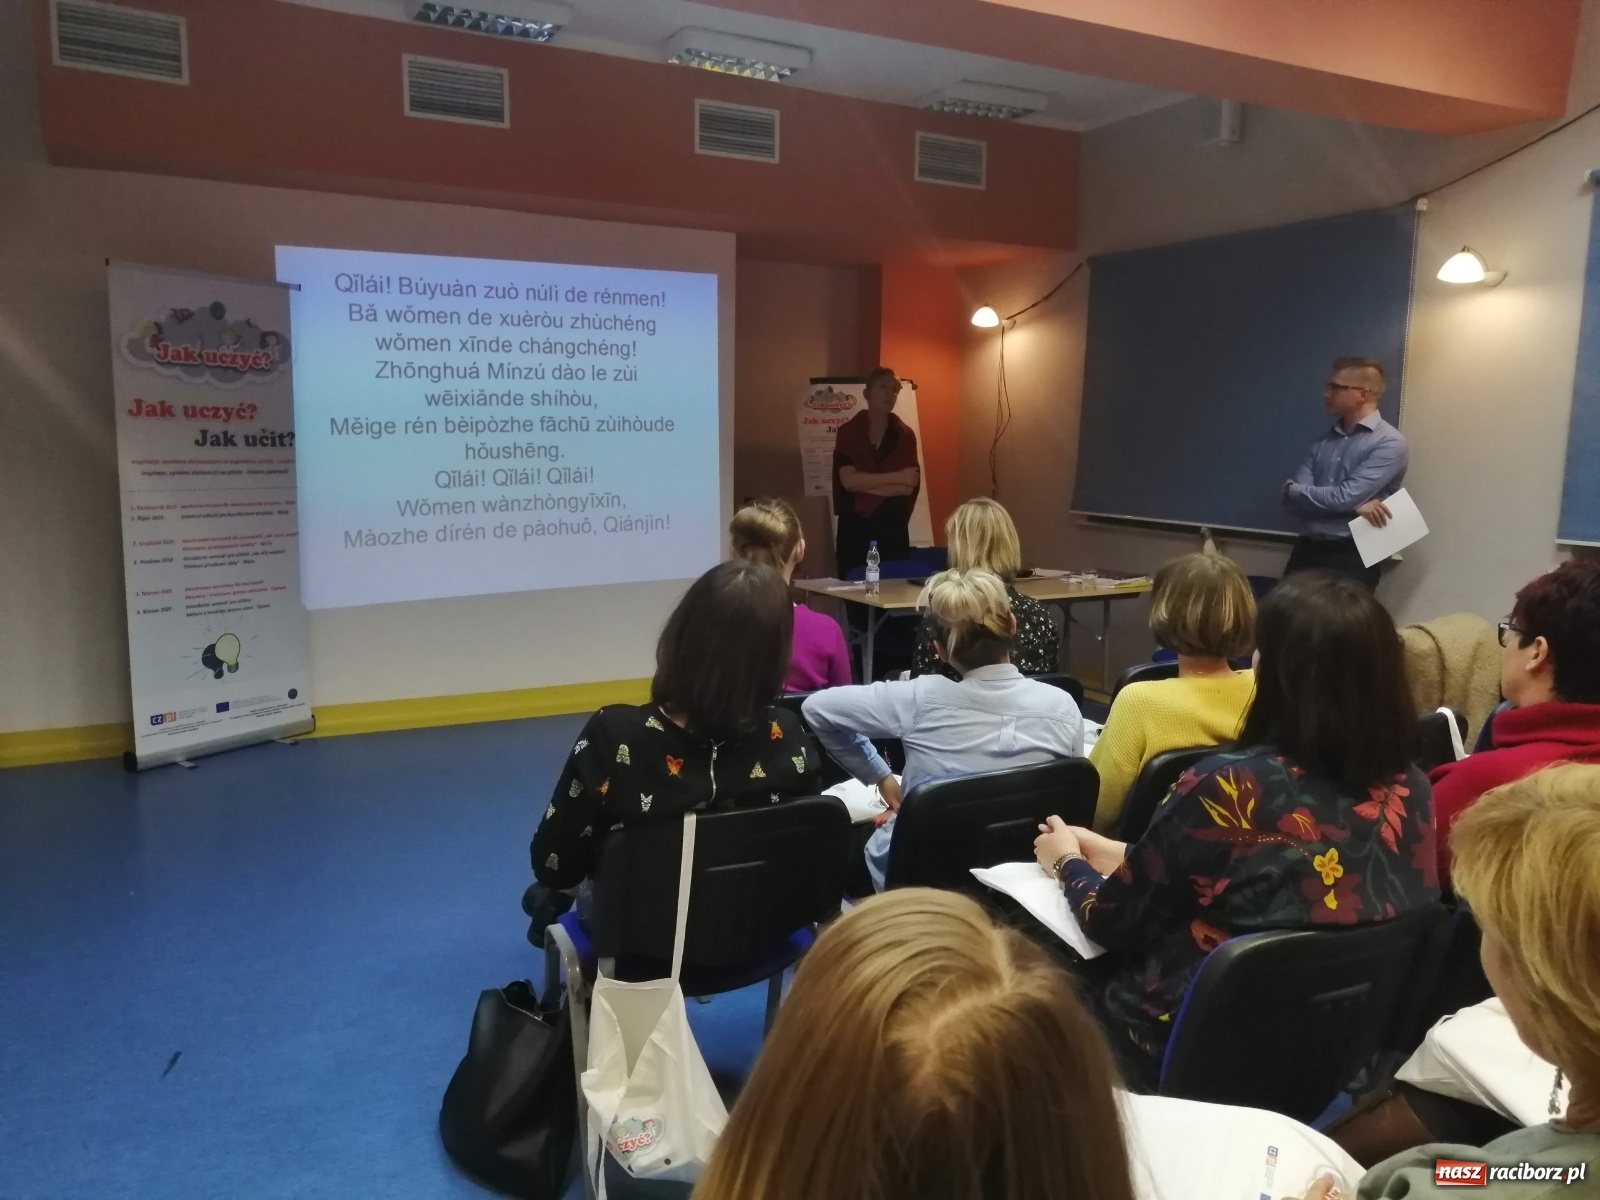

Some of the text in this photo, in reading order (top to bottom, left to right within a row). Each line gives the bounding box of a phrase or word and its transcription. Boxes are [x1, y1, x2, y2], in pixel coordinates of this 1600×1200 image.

[399, 276, 477, 301] Búyuàn
[483, 281, 519, 300] zuò
[564, 286, 588, 303] de
[594, 287, 666, 308] rénmen!
[467, 308, 493, 326] de
[499, 310, 563, 329] xuèròu
[570, 313, 656, 336] zhùchéng
[155, 343, 273, 371] Jak uczyć?
[458, 335, 513, 353] xīnde
[519, 336, 637, 360] chángchéng!
[375, 360, 638, 384] Zhōnghuá Mínzú dào le zùi
[127, 398, 258, 423] Jak uczyć?
[530, 389, 598, 410] shíhòu,
[404, 416, 438, 435] rén
[444, 415, 534, 438] bèipòzhe
[539, 415, 590, 433] fāchū
[596, 415, 675, 433] zùihòude
[803, 417, 819, 425] Jak
[194, 428, 296, 448] Jak učit?
[481, 492, 627, 514] wànzhòngyīxīn,
[343, 527, 428, 549] Màozhe
[435, 522, 486, 543] dírén
[492, 521, 517, 539] de
[617, 1132, 653, 1150] czyć?
